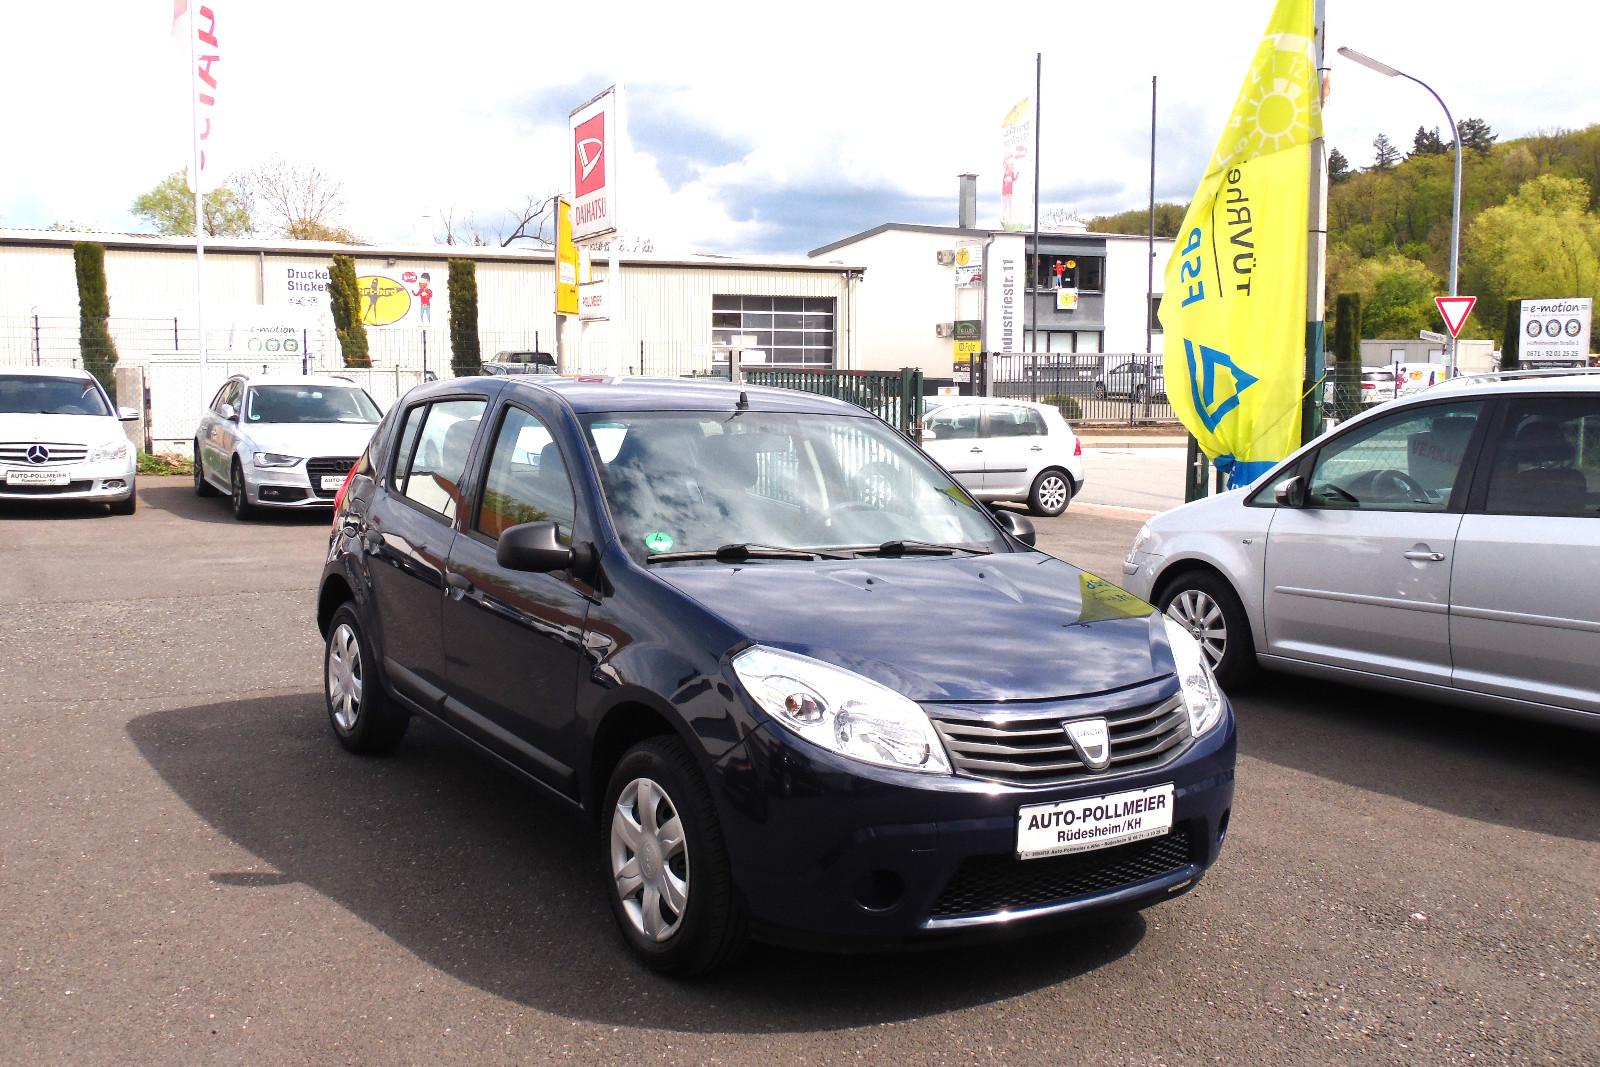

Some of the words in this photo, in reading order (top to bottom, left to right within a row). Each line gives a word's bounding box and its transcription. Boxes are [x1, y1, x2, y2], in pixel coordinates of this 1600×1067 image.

[575, 197, 607, 226] DAIHATSU
[1002, 274, 1014, 354] ndustriestr.
[1529, 301, 1580, 313] e-motion
[1076, 728, 1104, 738] DACIA
[1027, 794, 1166, 831] AUTO-POLLMEIER
